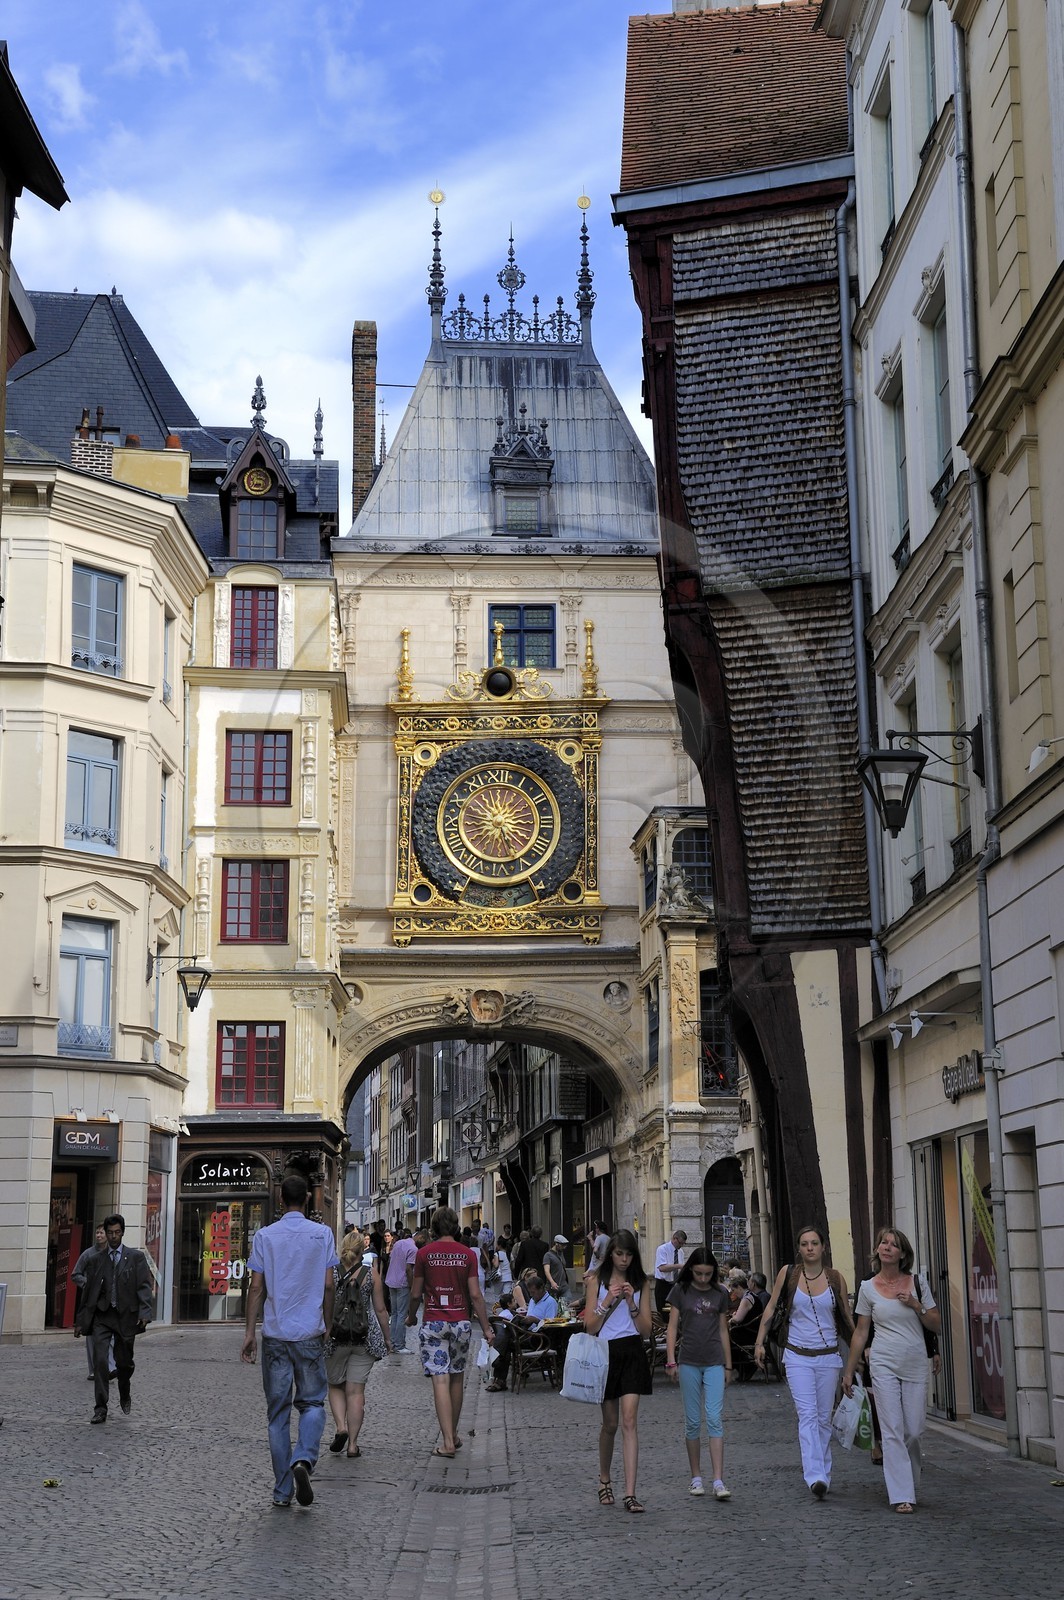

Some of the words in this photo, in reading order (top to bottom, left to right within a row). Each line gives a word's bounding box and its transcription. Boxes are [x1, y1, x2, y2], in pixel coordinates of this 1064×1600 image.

[487, 770, 509, 783] XII
[65, 1131, 100, 1145] GDM
[199, 1162, 251, 1180] Solaris
[202, 1250, 224, 1260] SALE
[208, 1211, 231, 1295] SOLDES
[973, 1265, 998, 1304] Tout
